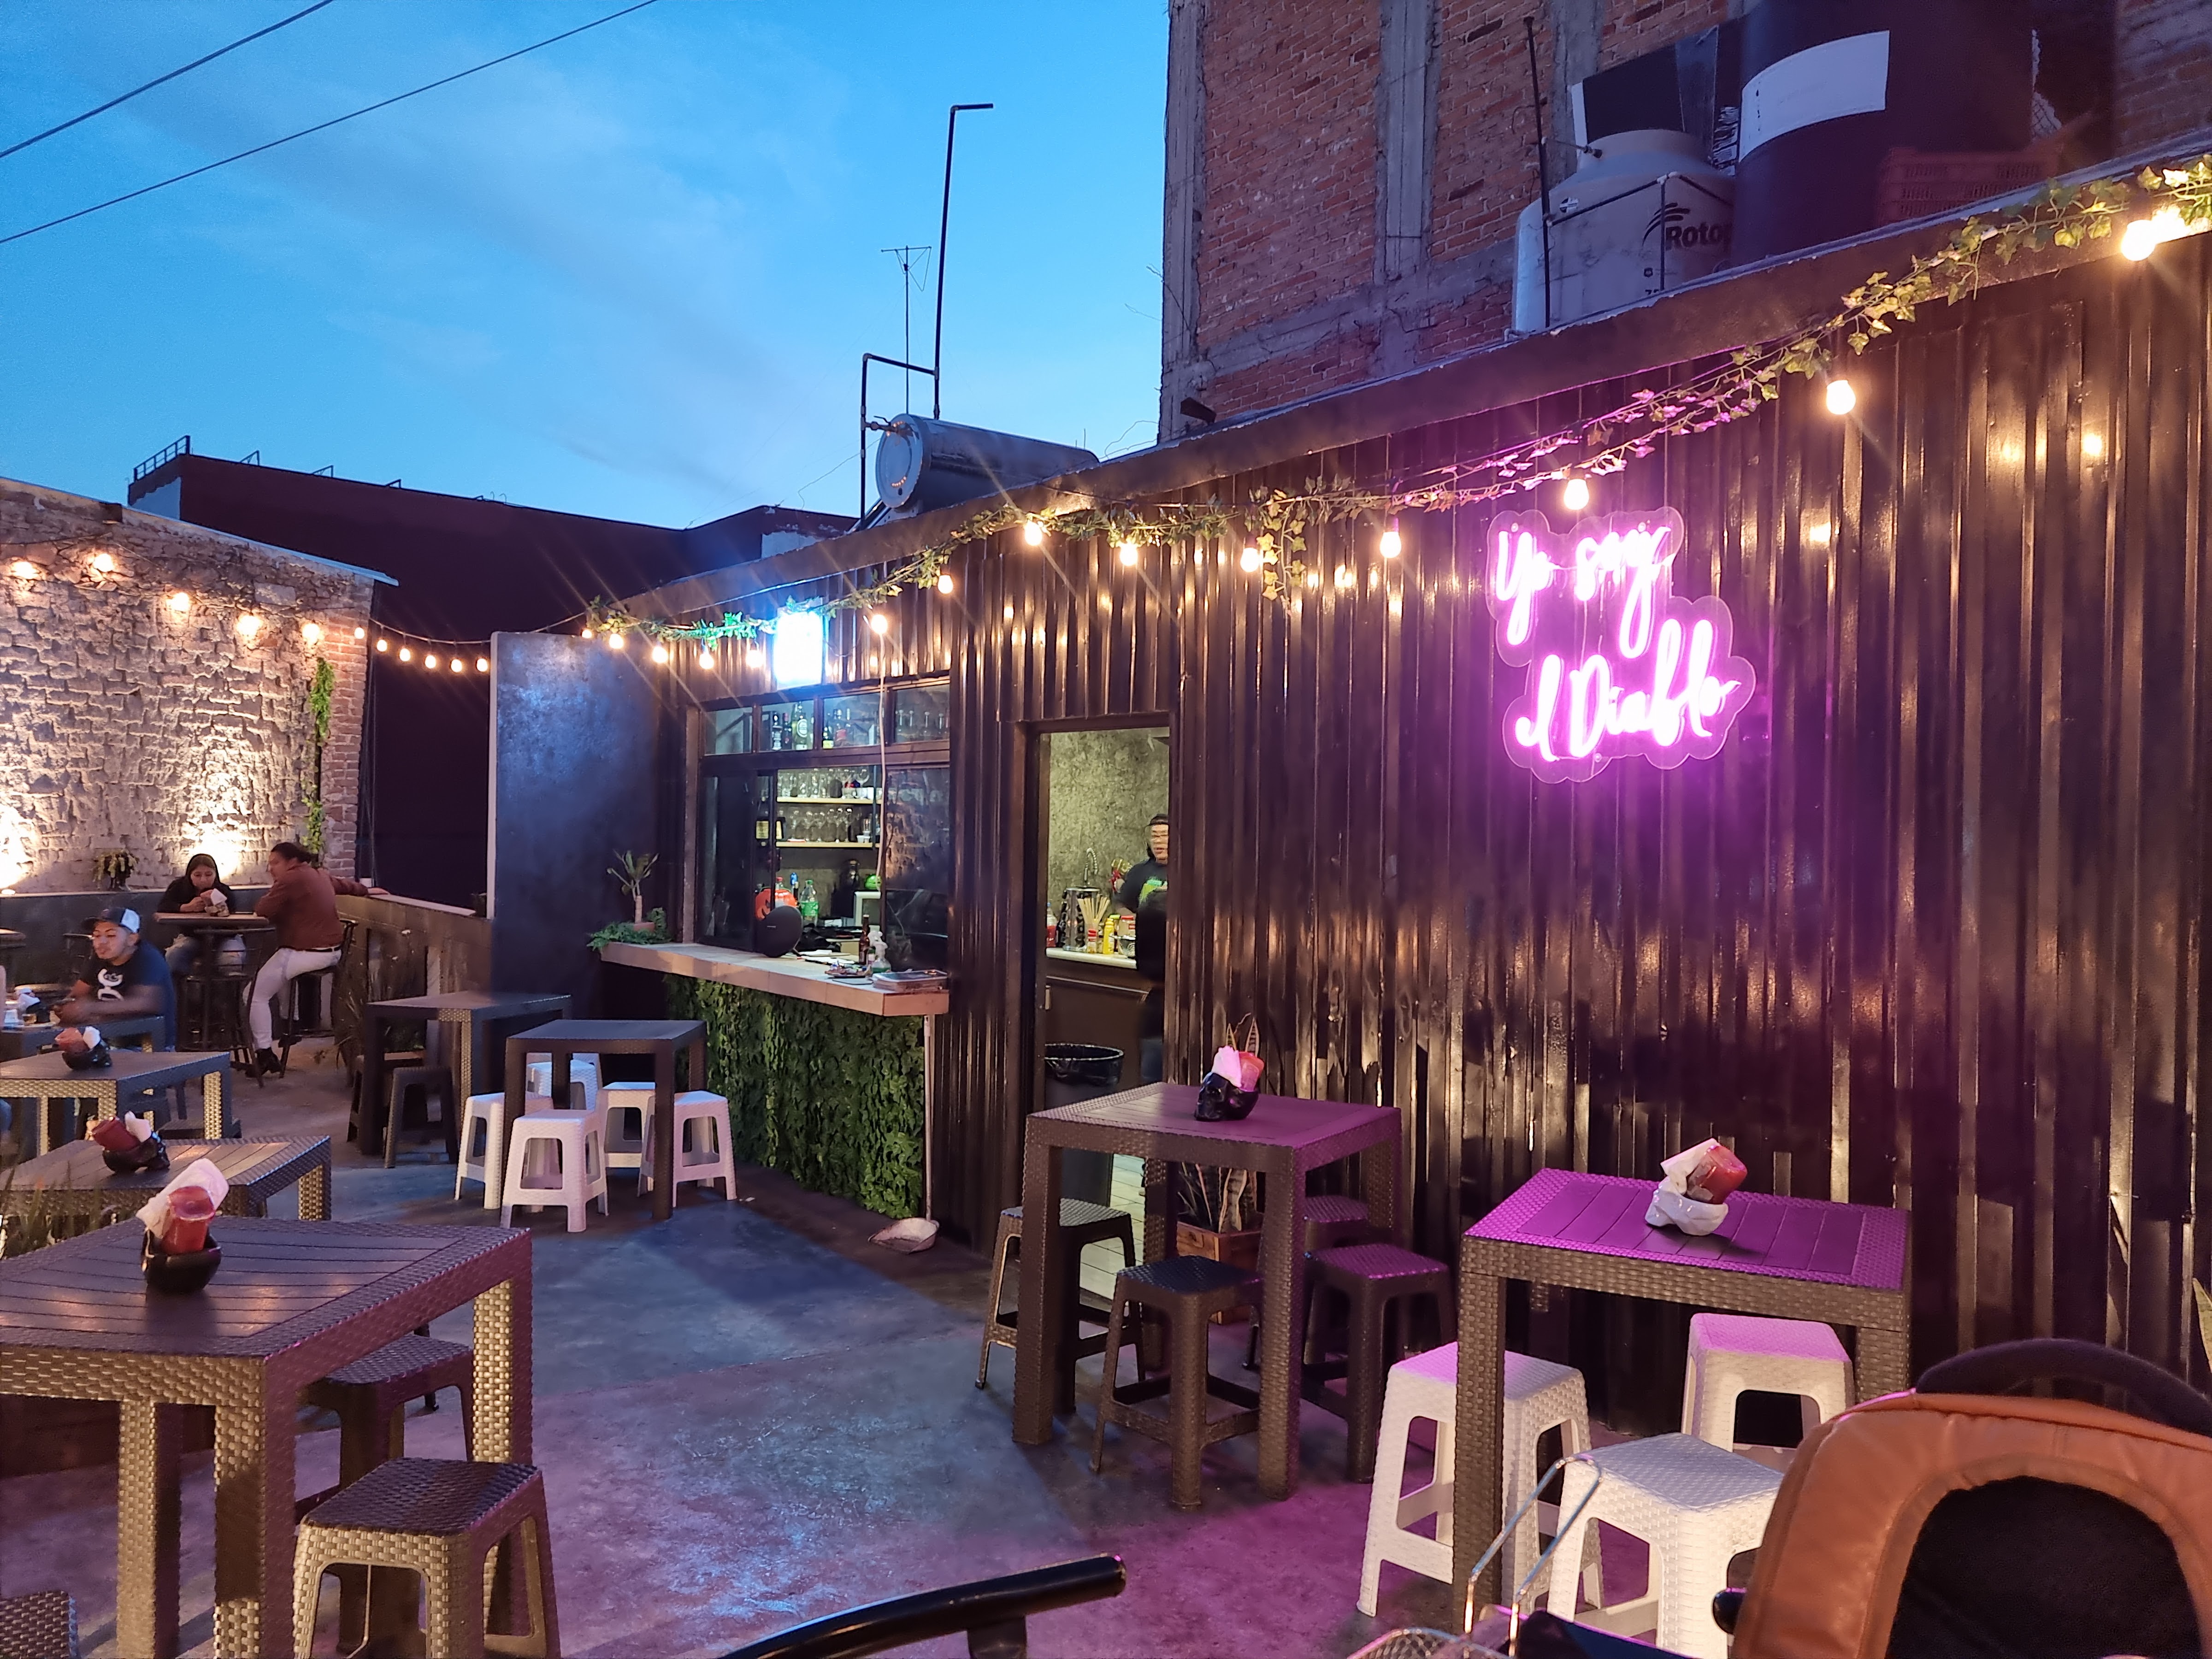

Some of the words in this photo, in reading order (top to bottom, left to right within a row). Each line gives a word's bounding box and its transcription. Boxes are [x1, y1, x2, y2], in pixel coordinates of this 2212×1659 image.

[1495, 531, 1560, 646] Yo
[1574, 526, 1676, 659] soy
[1569, 618, 1742, 758] Diablo
